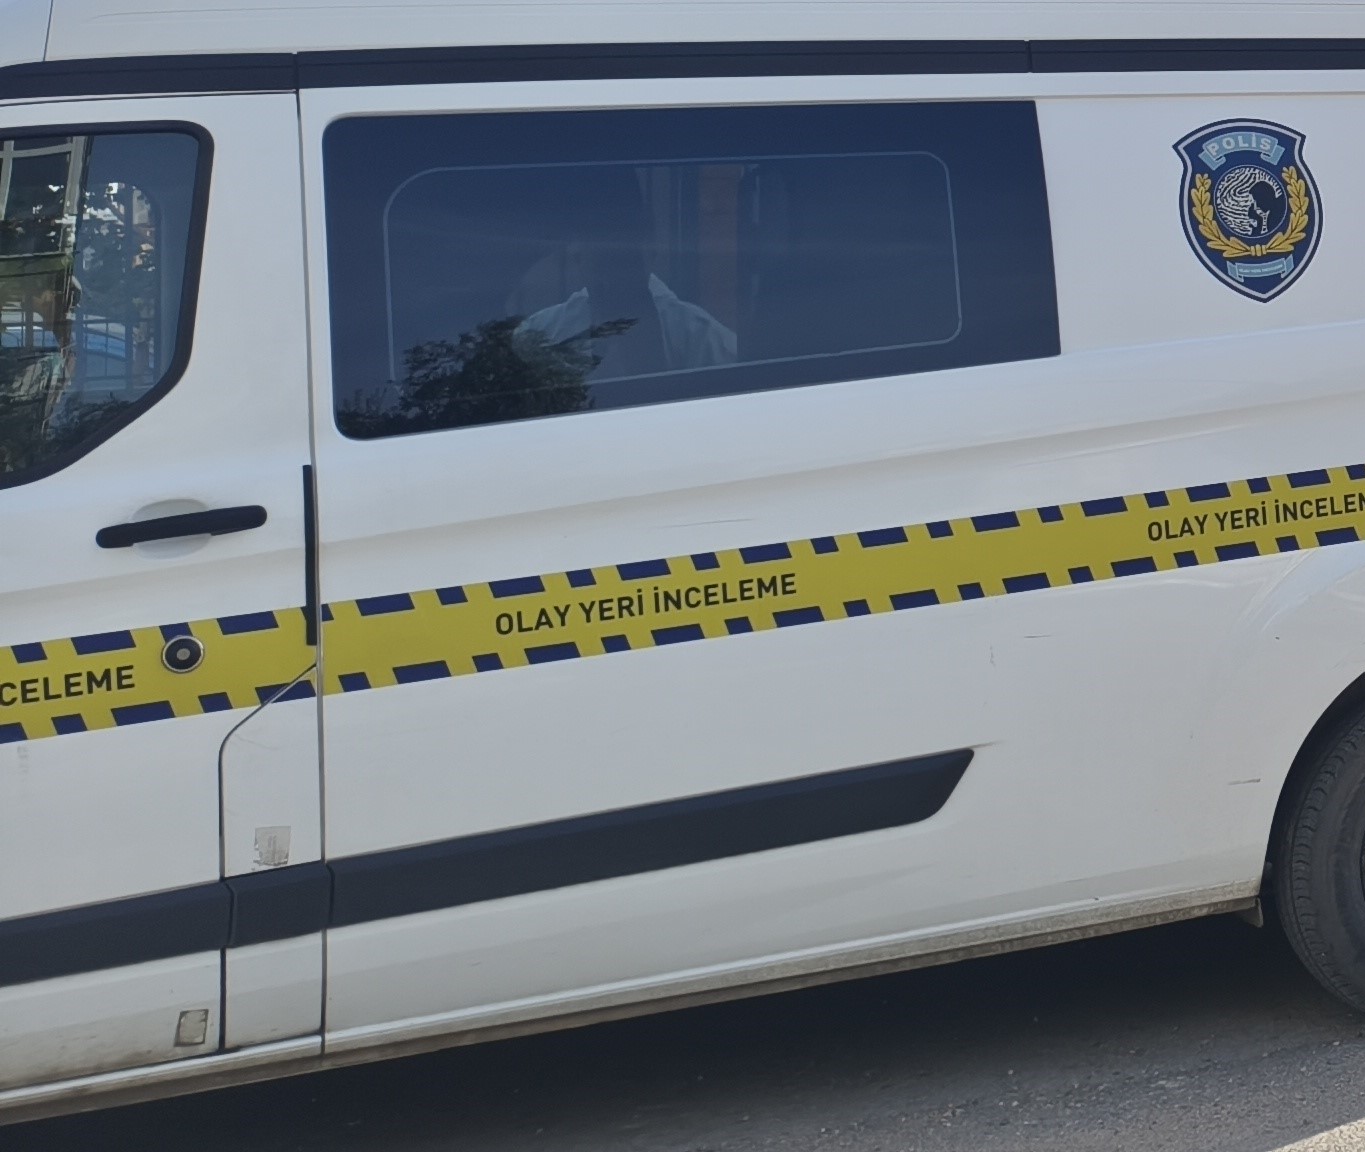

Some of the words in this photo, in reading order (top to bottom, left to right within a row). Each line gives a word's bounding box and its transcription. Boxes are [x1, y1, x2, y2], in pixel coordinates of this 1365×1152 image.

[1147, 513, 1209, 542] OLAY
[495, 603, 571, 636] OLAY
[0, 664, 136, 707] CELEME
